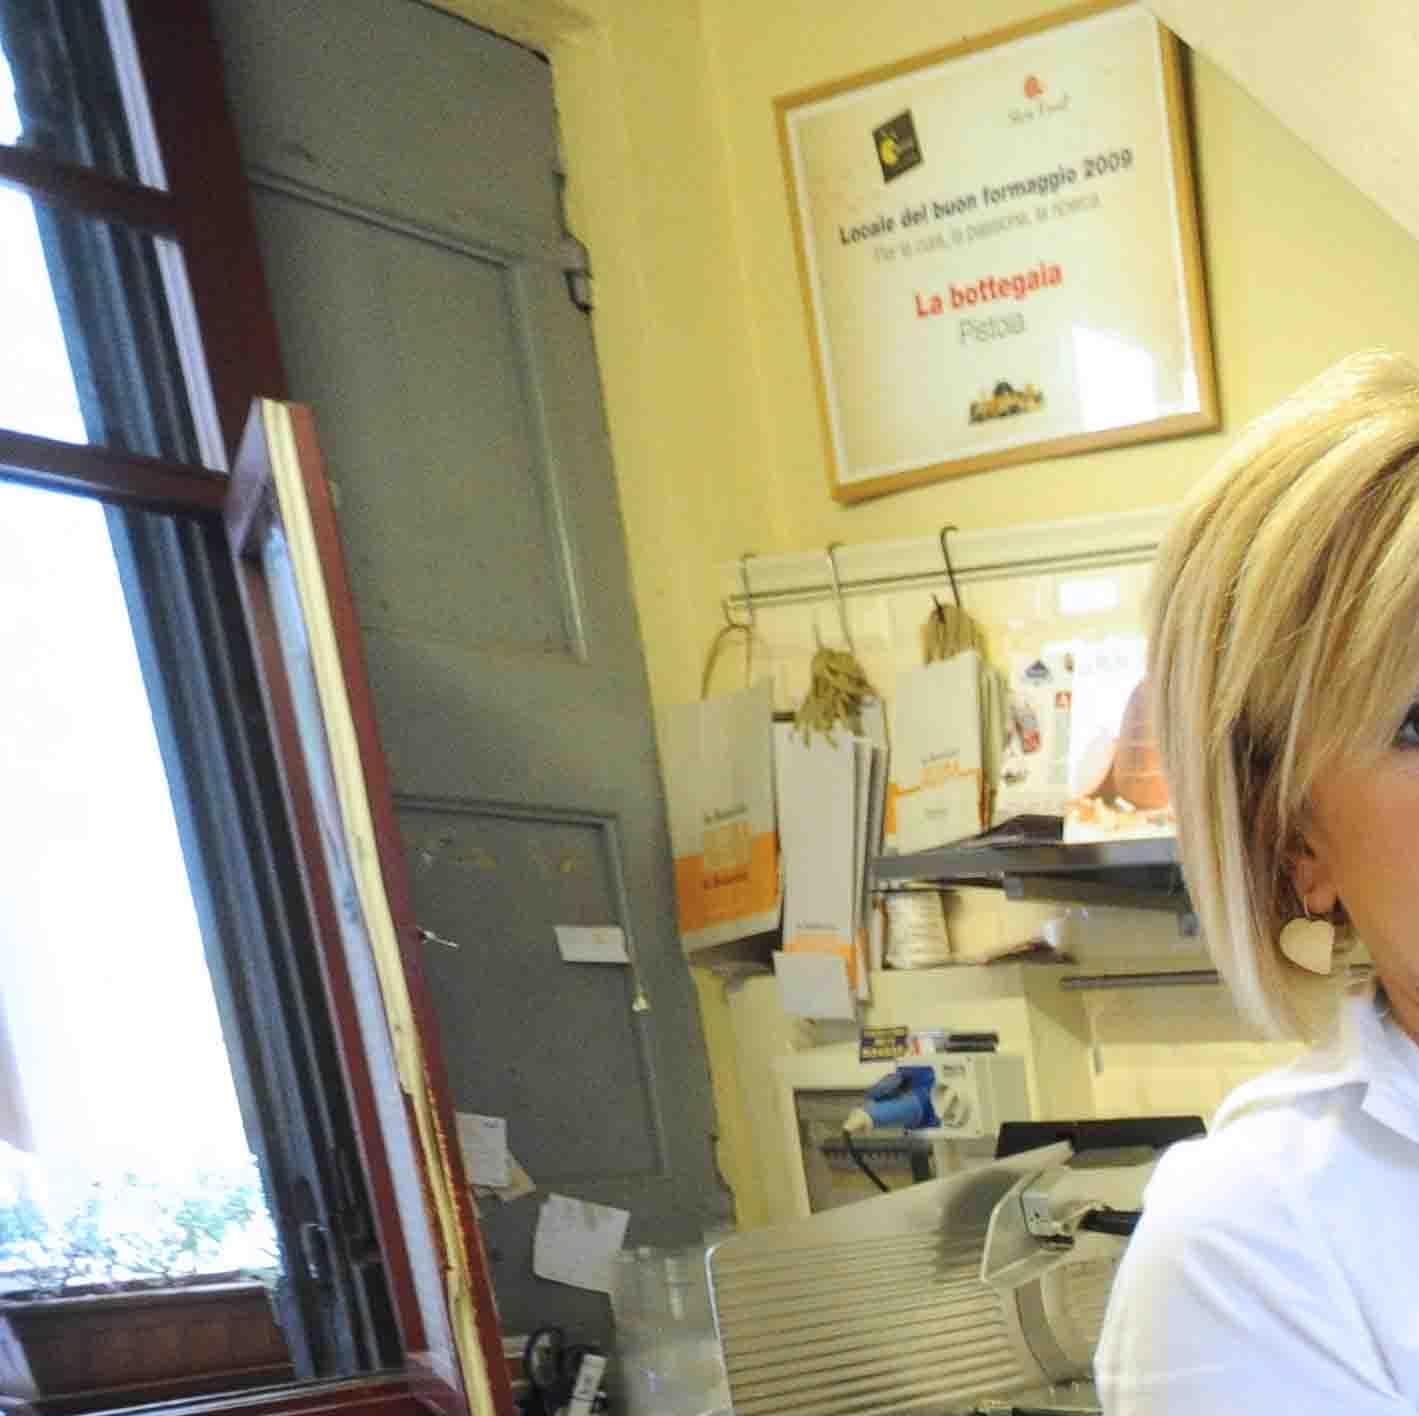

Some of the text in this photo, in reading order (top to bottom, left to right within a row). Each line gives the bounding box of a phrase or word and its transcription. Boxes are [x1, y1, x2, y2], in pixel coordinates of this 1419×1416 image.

[839, 147, 1134, 246] Locale del buon formaggio 2009
[915, 261, 1063, 319] La bottegaia
